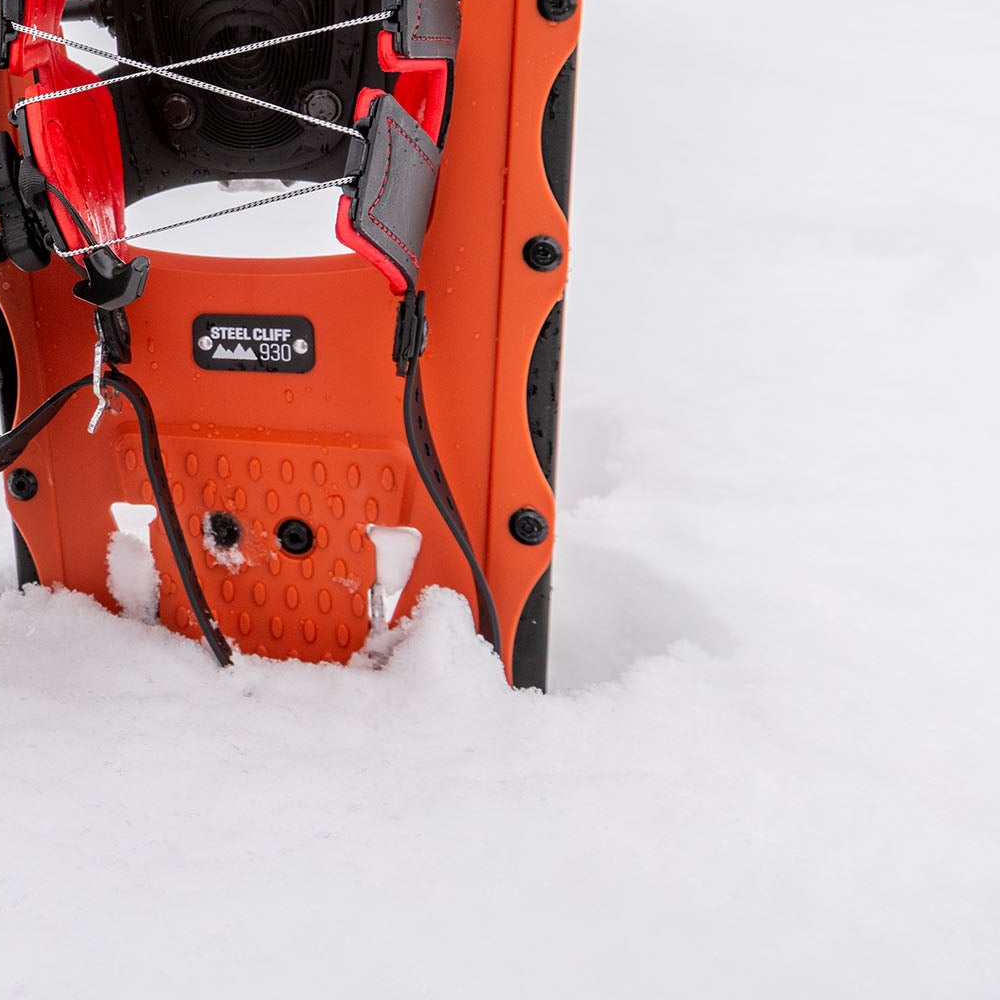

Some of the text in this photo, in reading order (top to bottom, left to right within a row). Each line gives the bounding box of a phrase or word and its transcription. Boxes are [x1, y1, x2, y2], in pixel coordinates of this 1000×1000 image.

[210, 326, 291, 342] STEEL CLIFF
[260, 343, 292, 362] 930
